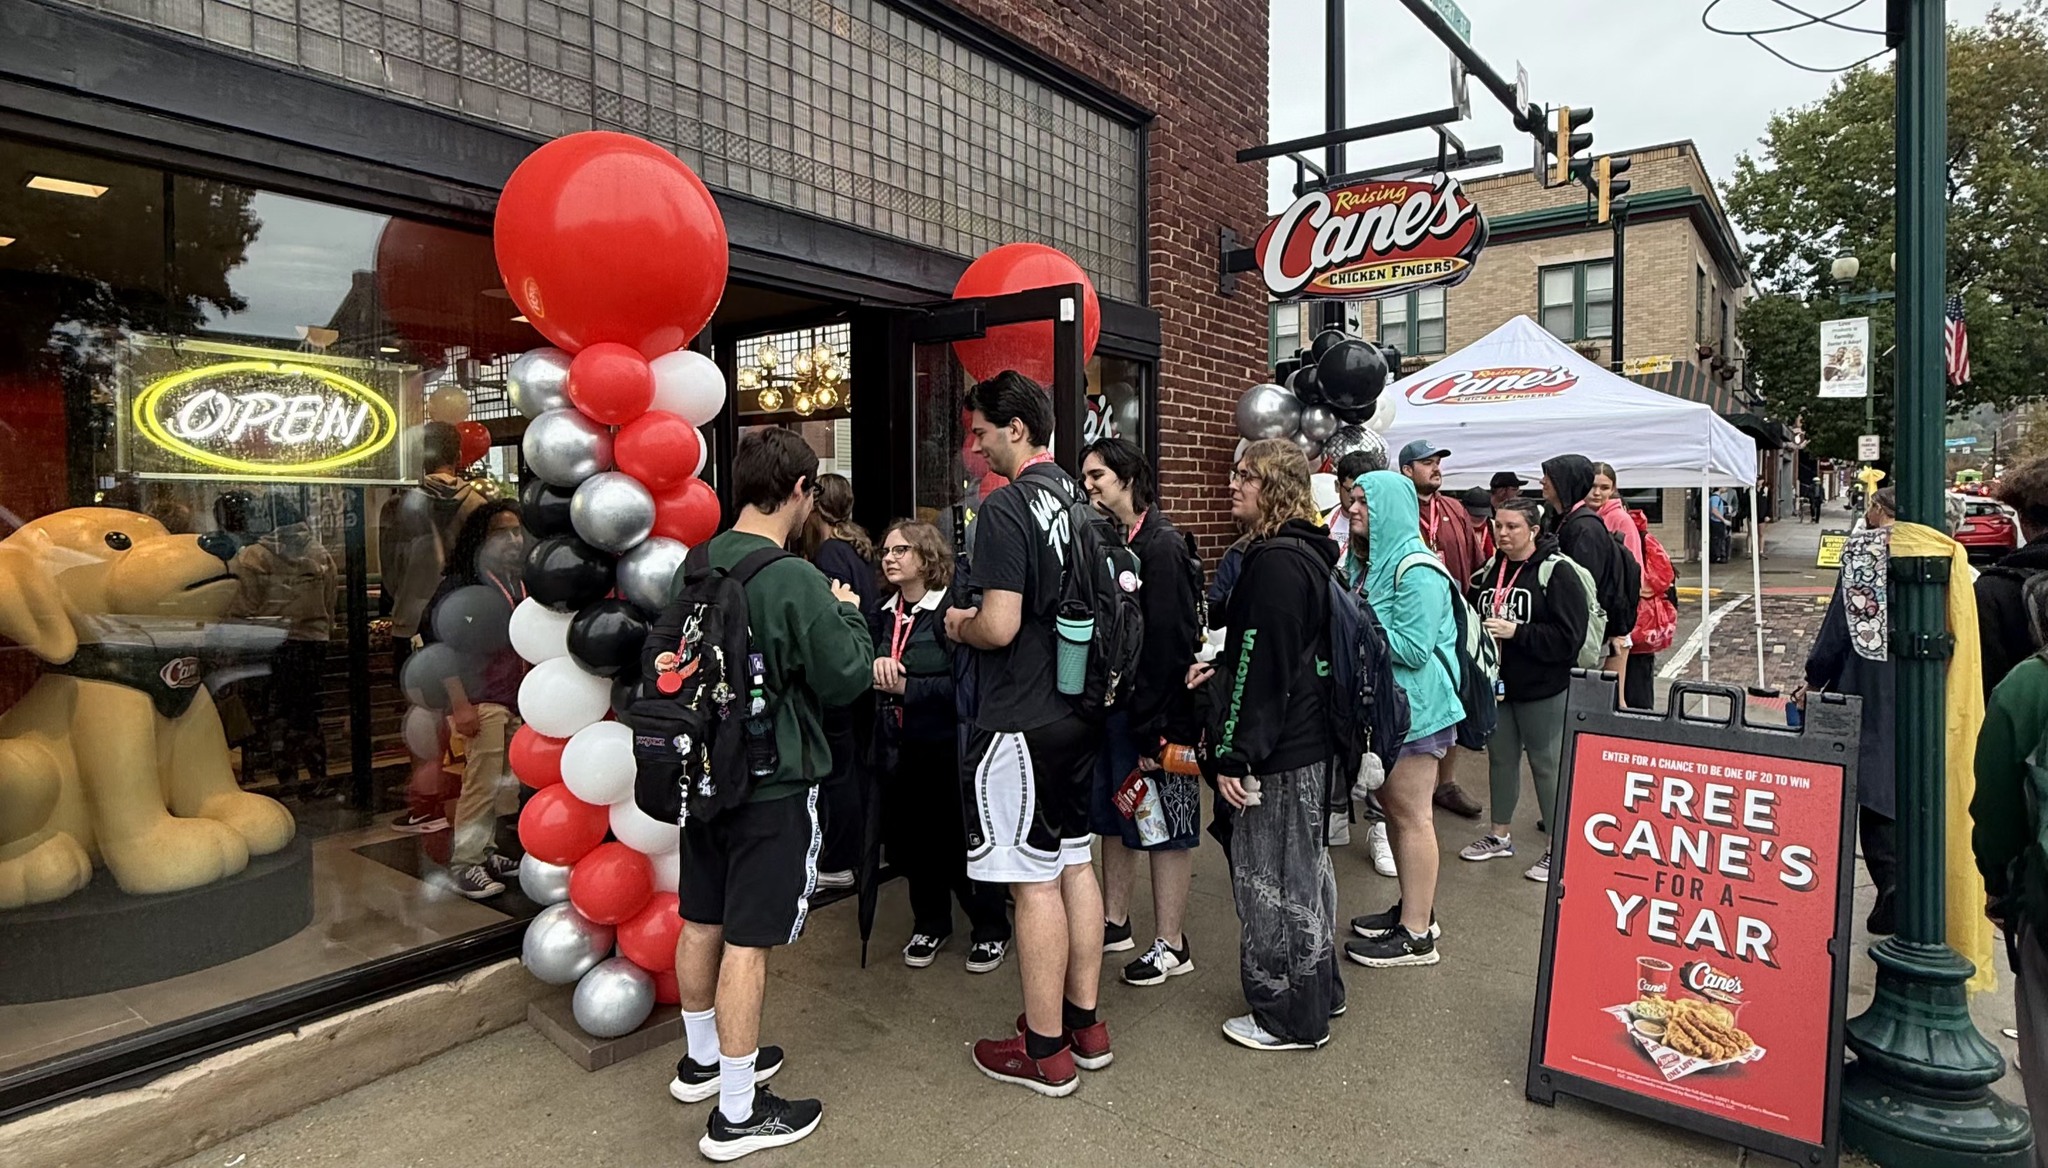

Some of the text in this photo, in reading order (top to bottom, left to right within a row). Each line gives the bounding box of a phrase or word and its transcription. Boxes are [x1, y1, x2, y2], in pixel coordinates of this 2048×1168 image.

[1335, 184, 1408, 213] Raising
[1263, 171, 1477, 294] Cane's
[1329, 261, 1452, 286] CHICKEN FINGERS
[1407, 364, 1580, 407] Cane's
[1475, 367, 1532, 379] Raising
[166, 388, 370, 447] OPEN
[1602, 750, 1811, 790] ENTER FOR A CHANCE TO BE ONE OF 20 TO WIN
[1623, 771, 1780, 835] FREE
[1583, 812, 1818, 892] CANE'S
[1655, 871, 1734, 907] FOR A
[1605, 888, 1781, 969] YEAR
[1637, 977, 1668, 993] Cane's
[1689, 962, 1744, 994] Cane's
[1666, 1058, 1697, 1080] ONE LOVE
